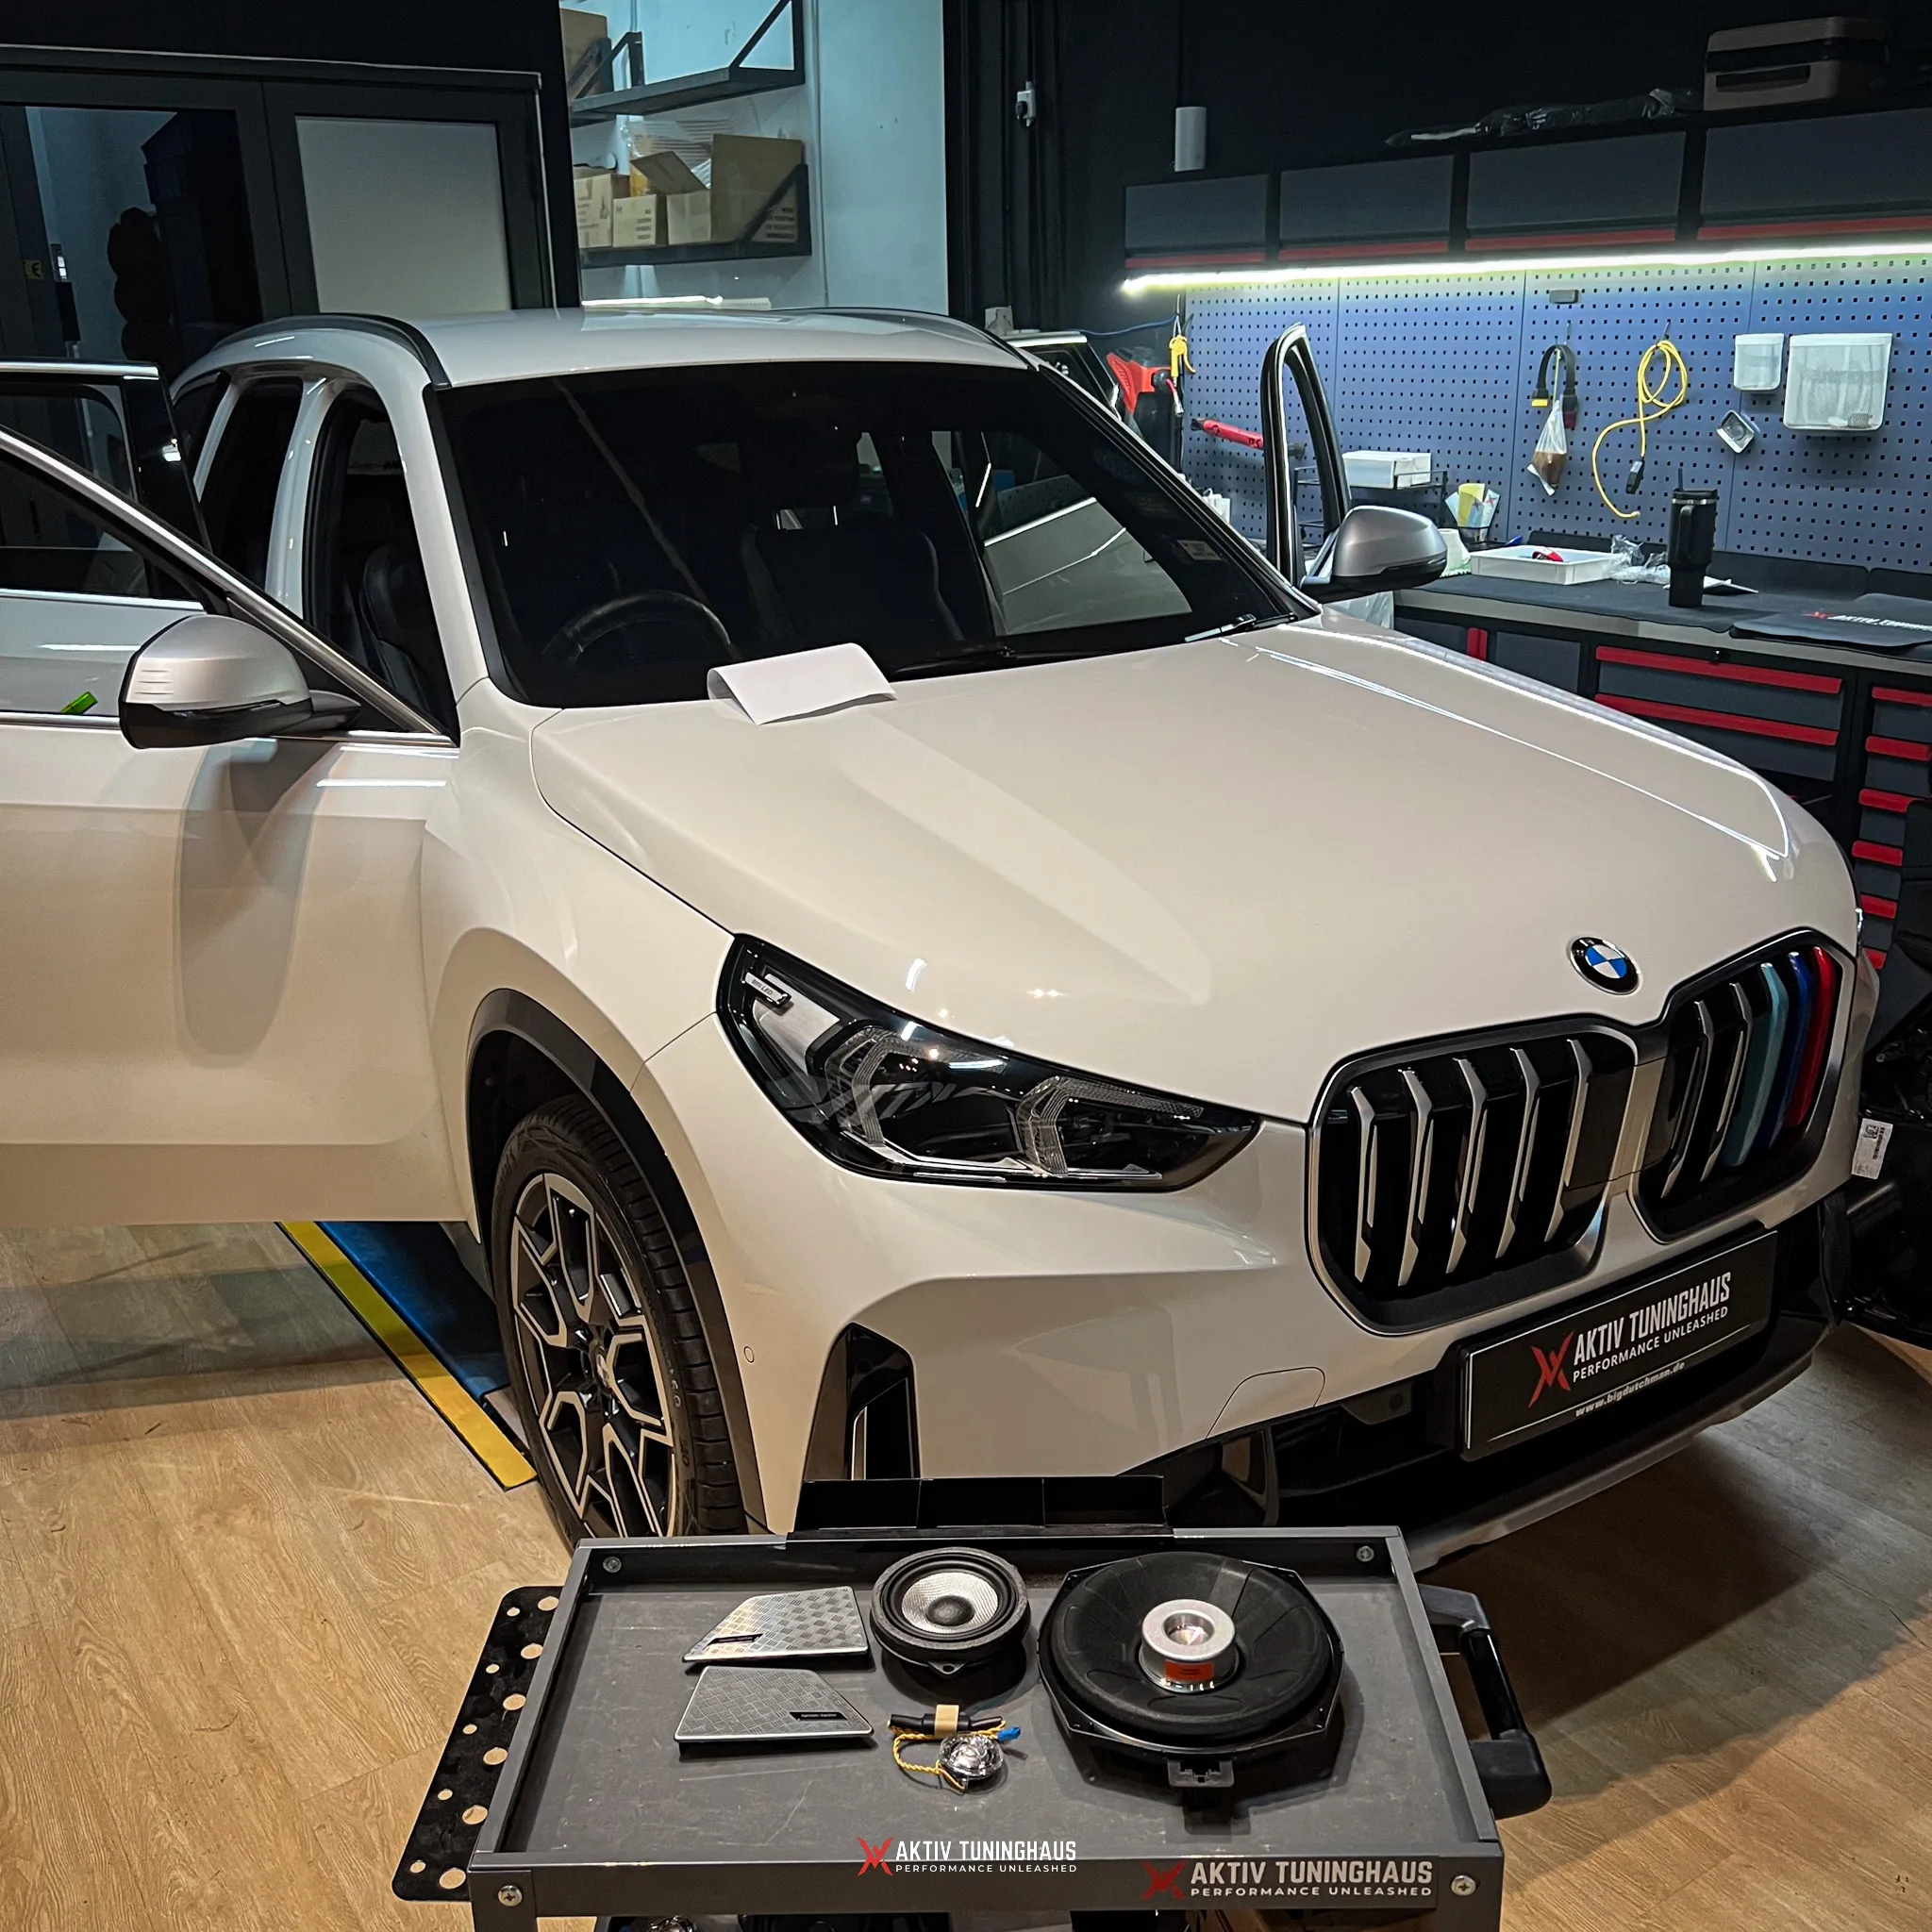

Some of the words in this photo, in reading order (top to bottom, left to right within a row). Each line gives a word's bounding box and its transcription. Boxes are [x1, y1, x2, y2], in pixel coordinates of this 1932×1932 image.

[1573, 1336, 1660, 1383] PERFORMANCE
[1663, 1306, 1728, 1343] UNLEASHED
[1574, 1317, 1624, 1366] AKTIV
[1629, 1272, 1731, 1342] TUNINGHAUS
[1575, 1361, 1685, 1417] www.bigdutchman.de
[1191, 1861, 1266, 1885] AKTIV
[1275, 1860, 1433, 1884] TUNINGHAUS
[1191, 1887, 1320, 1896] PERFORMANCE
[1329, 1887, 1432, 1896] UNLEASHED
